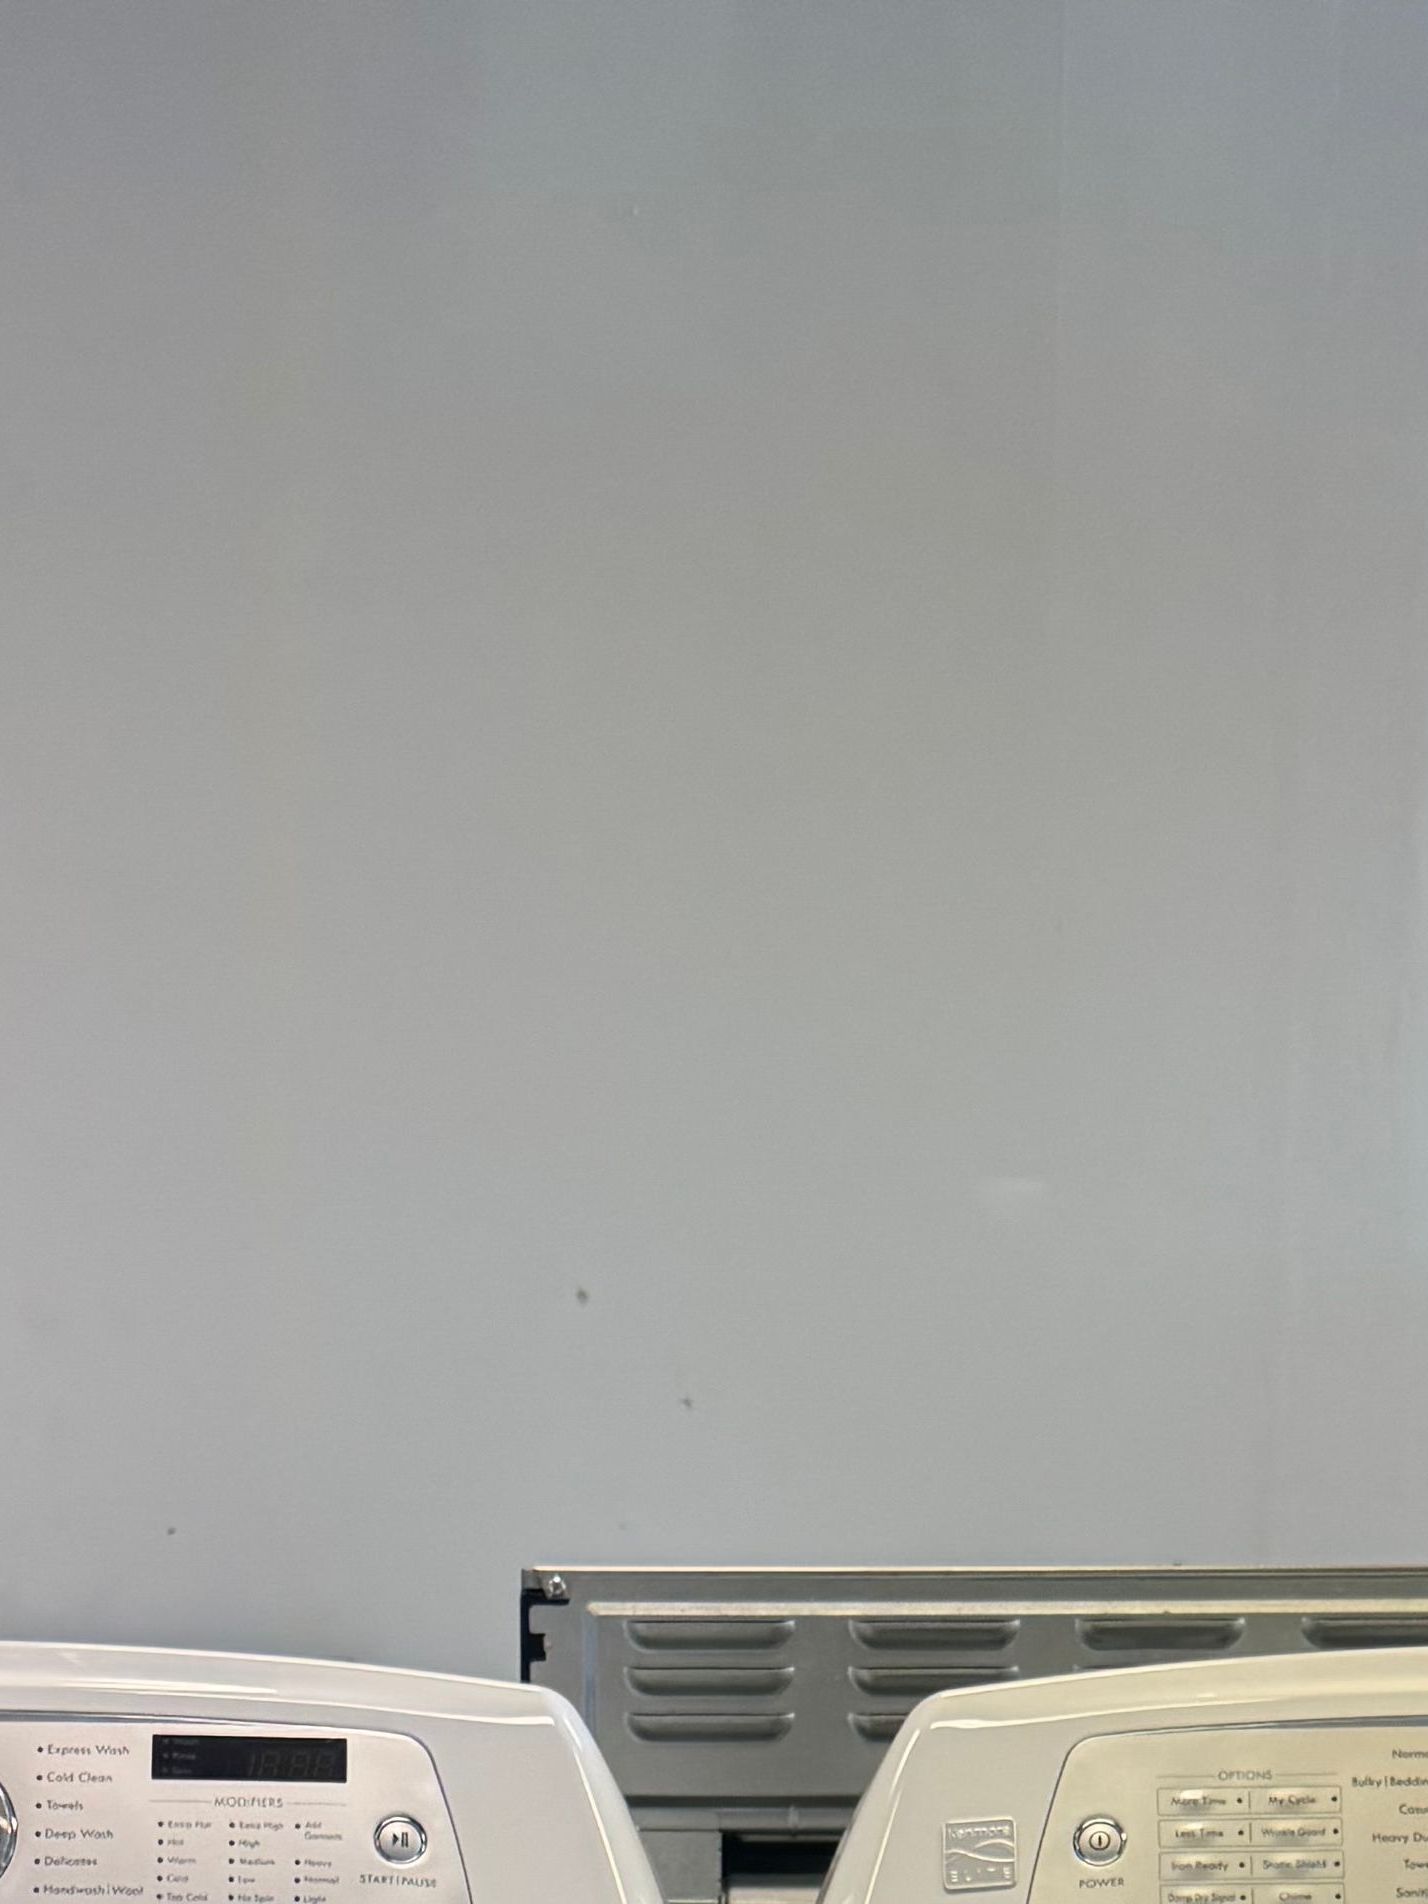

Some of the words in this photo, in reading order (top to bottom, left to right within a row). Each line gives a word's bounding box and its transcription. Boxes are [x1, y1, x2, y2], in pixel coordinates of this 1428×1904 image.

[47, 1744, 91, 1756] Express
[95, 1745, 130, 1755] Wash
[47, 1772, 74, 1783] Cold
[78, 1771, 113, 1783] Clean
[1217, 1770, 1273, 1782] OPTIONS
[47, 1800, 84, 1811] Towels
[214, 1796, 284, 1808] MODIFIERS
[1202, 1796, 1227, 1806] Time
[1268, 1796, 1284, 1806] My
[1288, 1795, 1317, 1807] Cycle
[45, 1828, 76, 1840] Deep
[80, 1829, 114, 1839] Wash
[1200, 1829, 1224, 1838] Time
[1372, 1832, 1409, 1844] Heavy
[44, 1856, 98, 1866] Delicates
[1171, 1861, 1193, 1871] Iron
[1195, 1861, 1229, 1872] Ready
[1079, 1877, 1125, 1889] POWER
